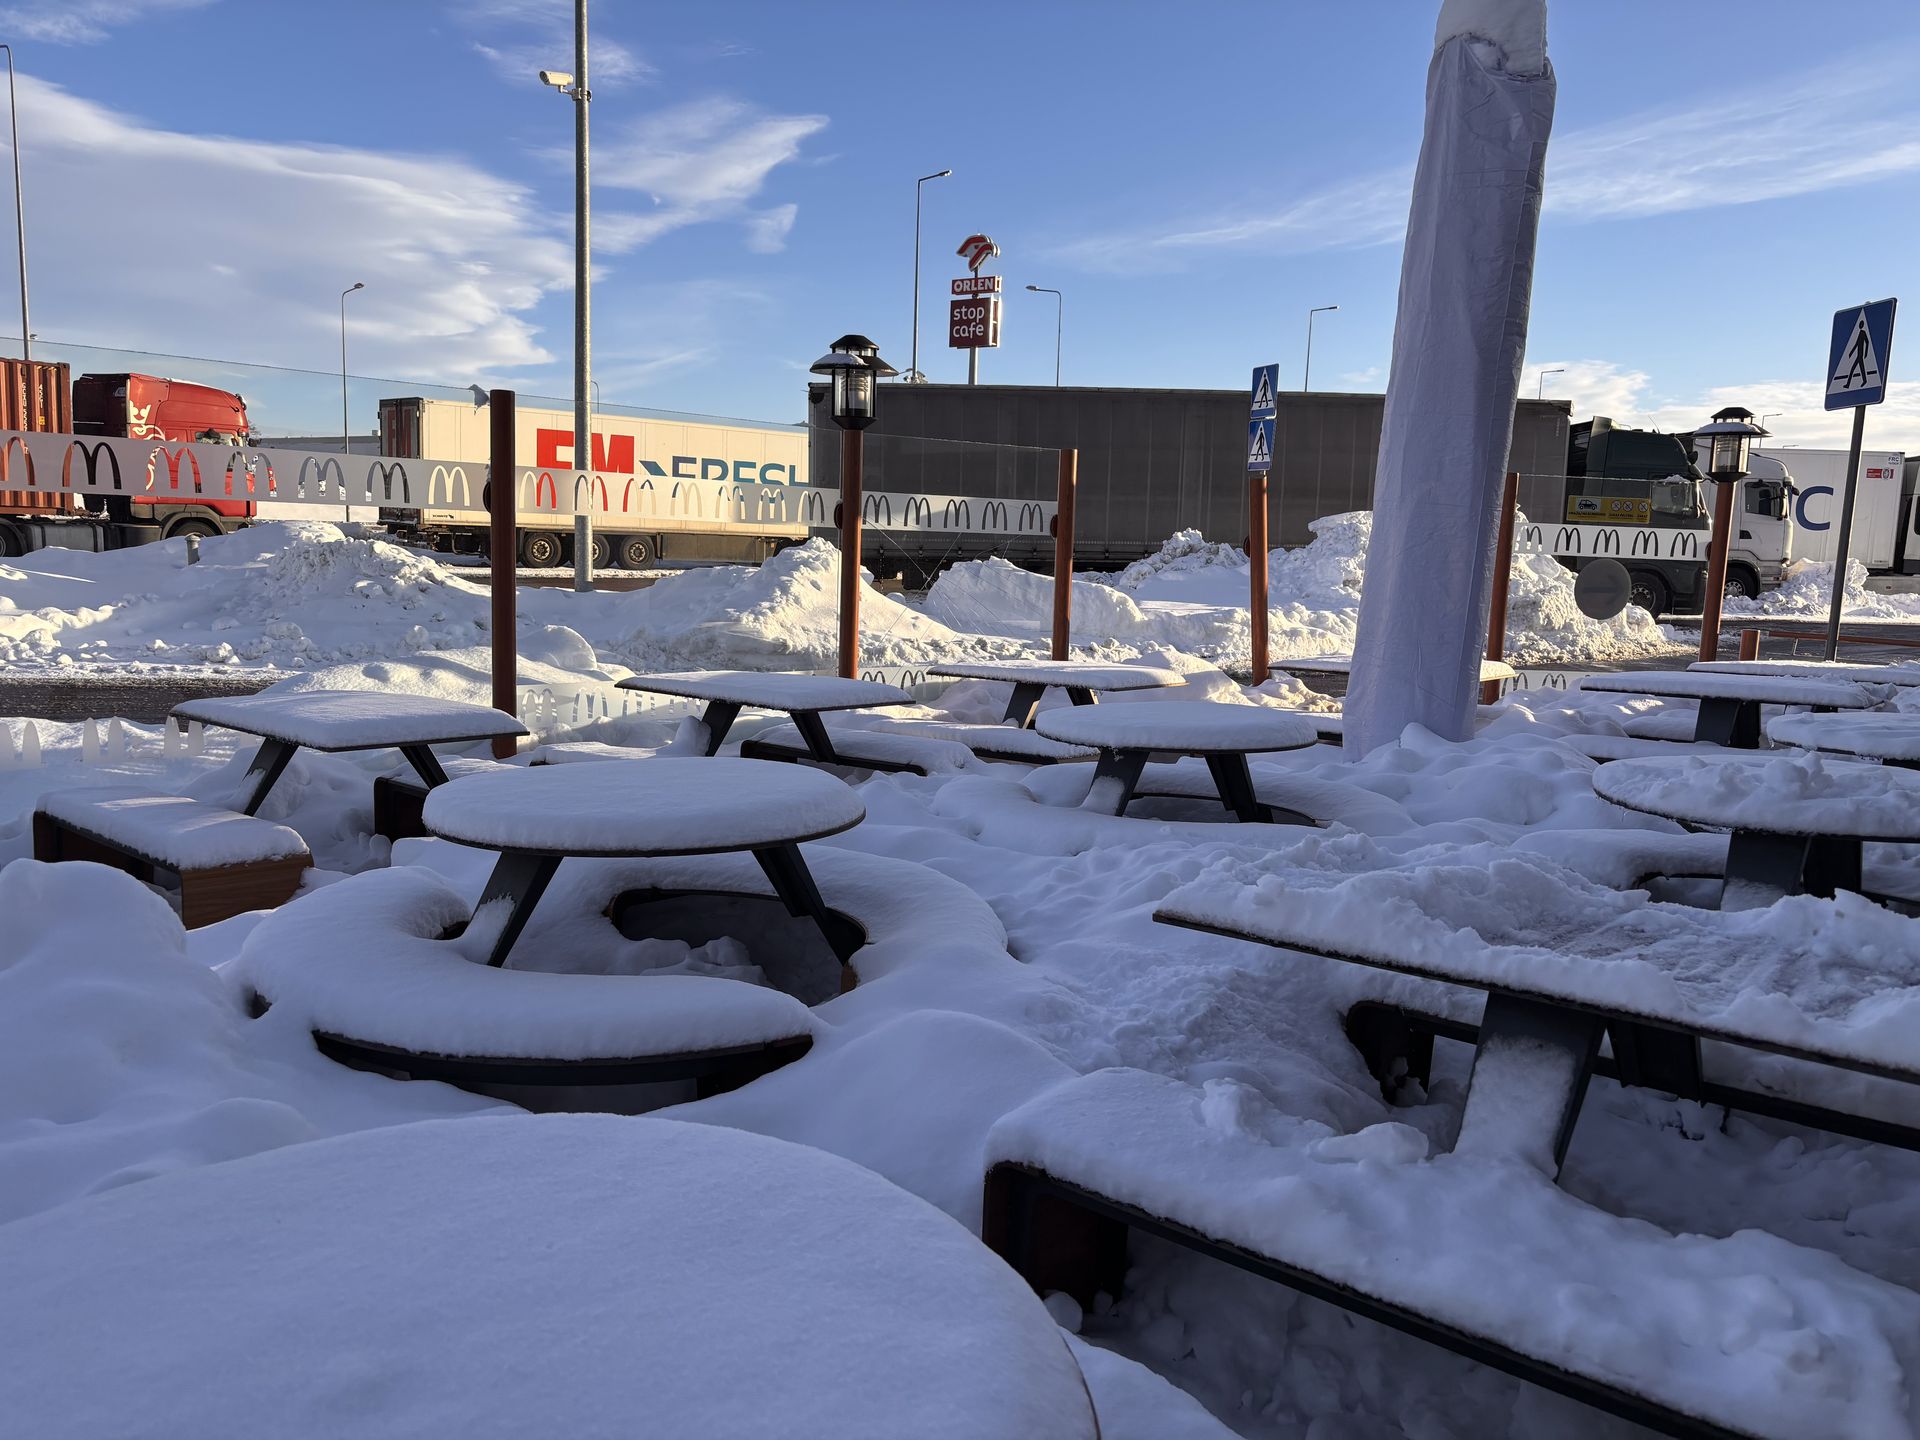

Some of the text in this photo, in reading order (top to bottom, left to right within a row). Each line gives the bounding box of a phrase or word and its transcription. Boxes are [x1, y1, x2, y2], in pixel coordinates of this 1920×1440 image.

[953, 278, 994, 293] ORLEN
[953, 305, 985, 323] stop
[952, 321, 984, 339] cafe
[1788, 485, 1834, 531] C
